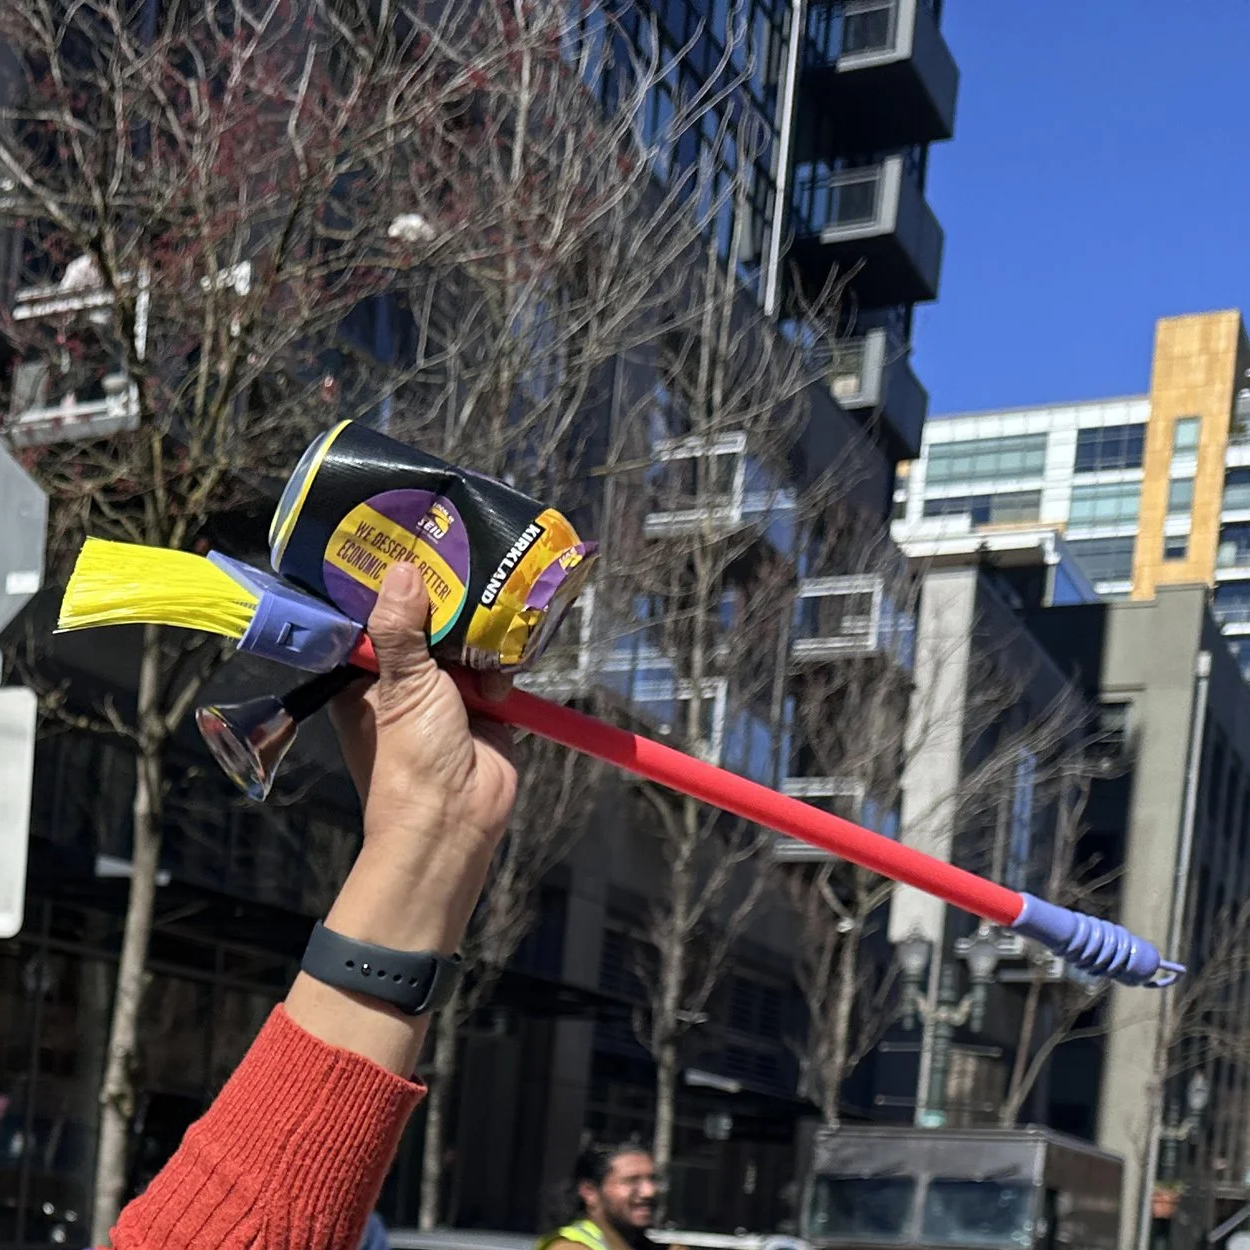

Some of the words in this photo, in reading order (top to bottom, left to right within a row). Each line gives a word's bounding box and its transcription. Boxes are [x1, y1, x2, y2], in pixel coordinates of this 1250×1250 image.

[355, 521, 376, 543] WE
[372, 532, 420, 564] DESERVE
[417, 518, 445, 539] SEIU
[336, 538, 388, 581] ECONOMIC
[481, 523, 541, 604] KIRKLAND
